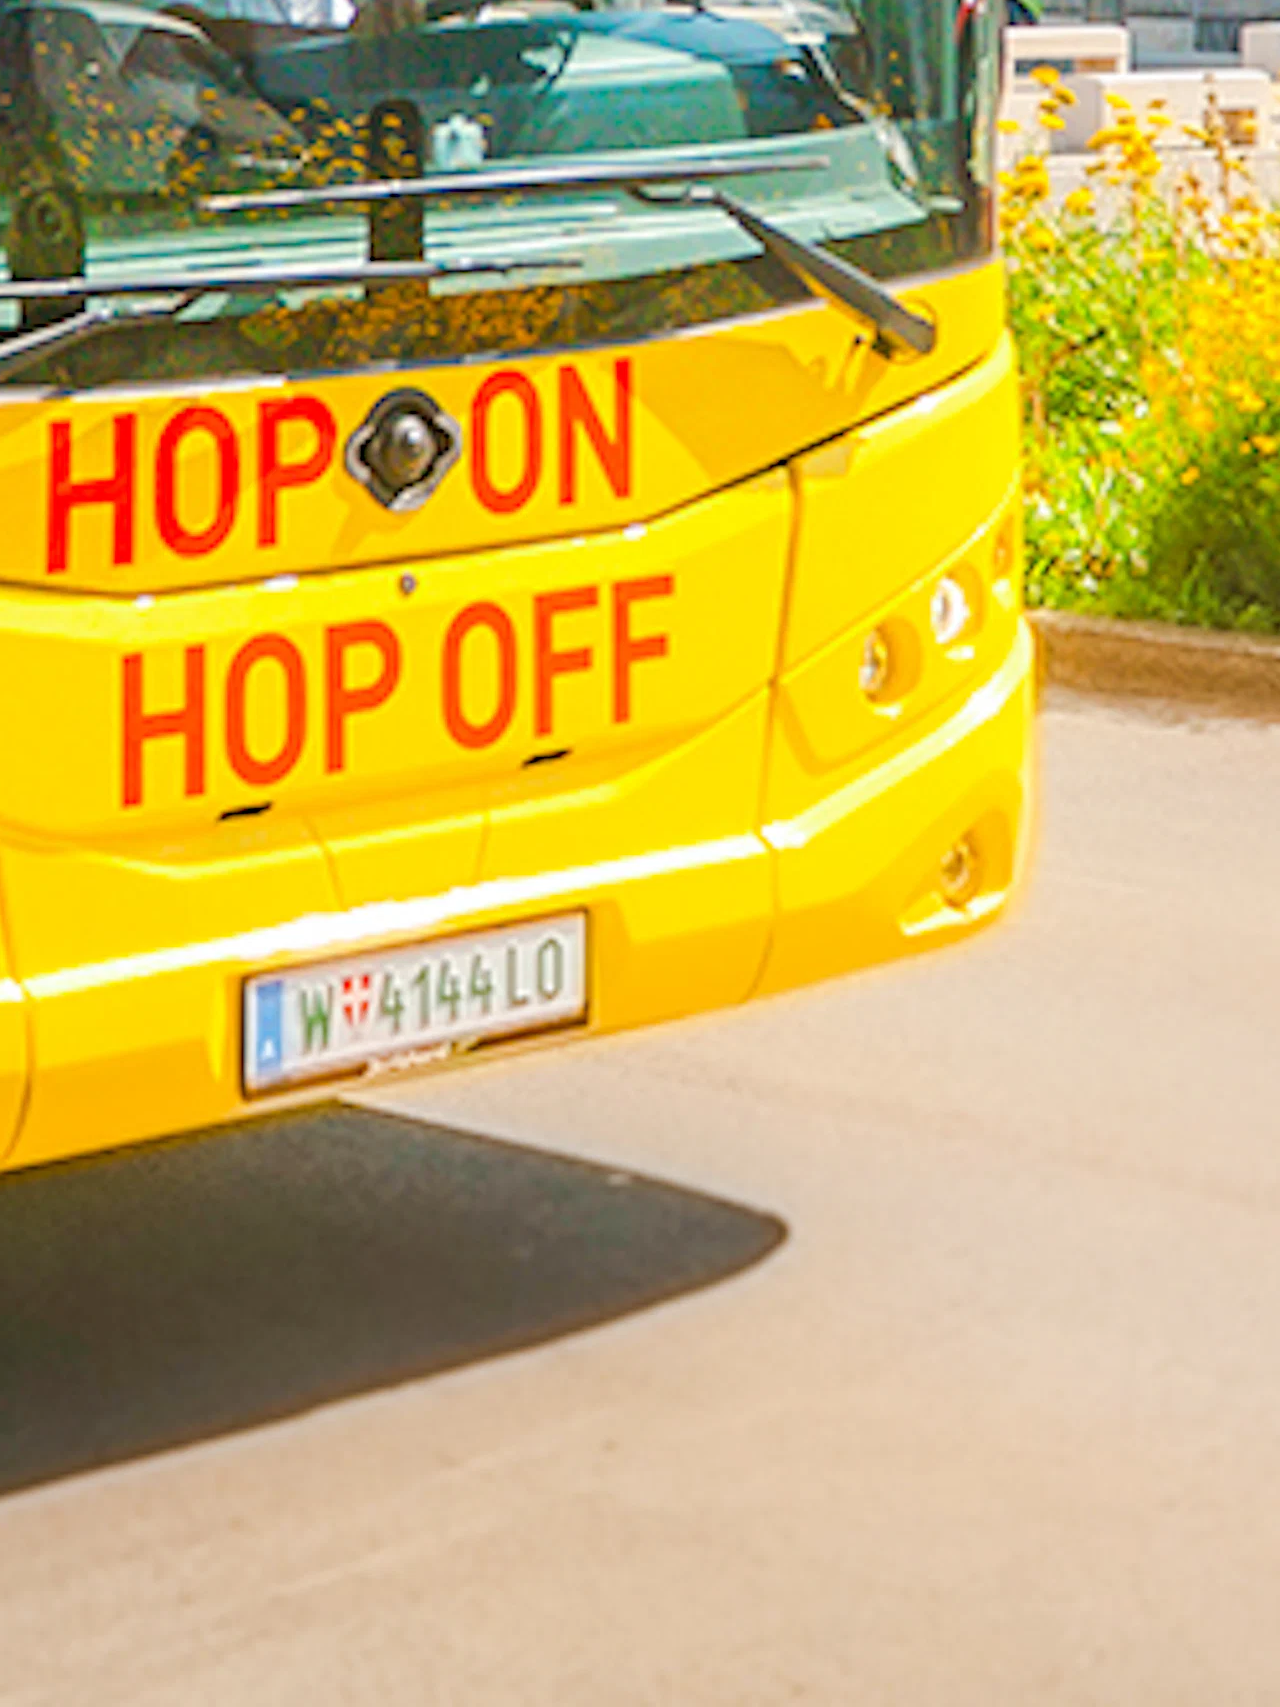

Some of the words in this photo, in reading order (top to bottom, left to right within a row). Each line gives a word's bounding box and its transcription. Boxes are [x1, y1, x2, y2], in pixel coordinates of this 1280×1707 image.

[46, 395, 337, 574] HOP
[470, 357, 633, 515] ON
[122, 619, 401, 809] HOP
[441, 575, 674, 751] OFF
[300, 981, 333, 1057] W
